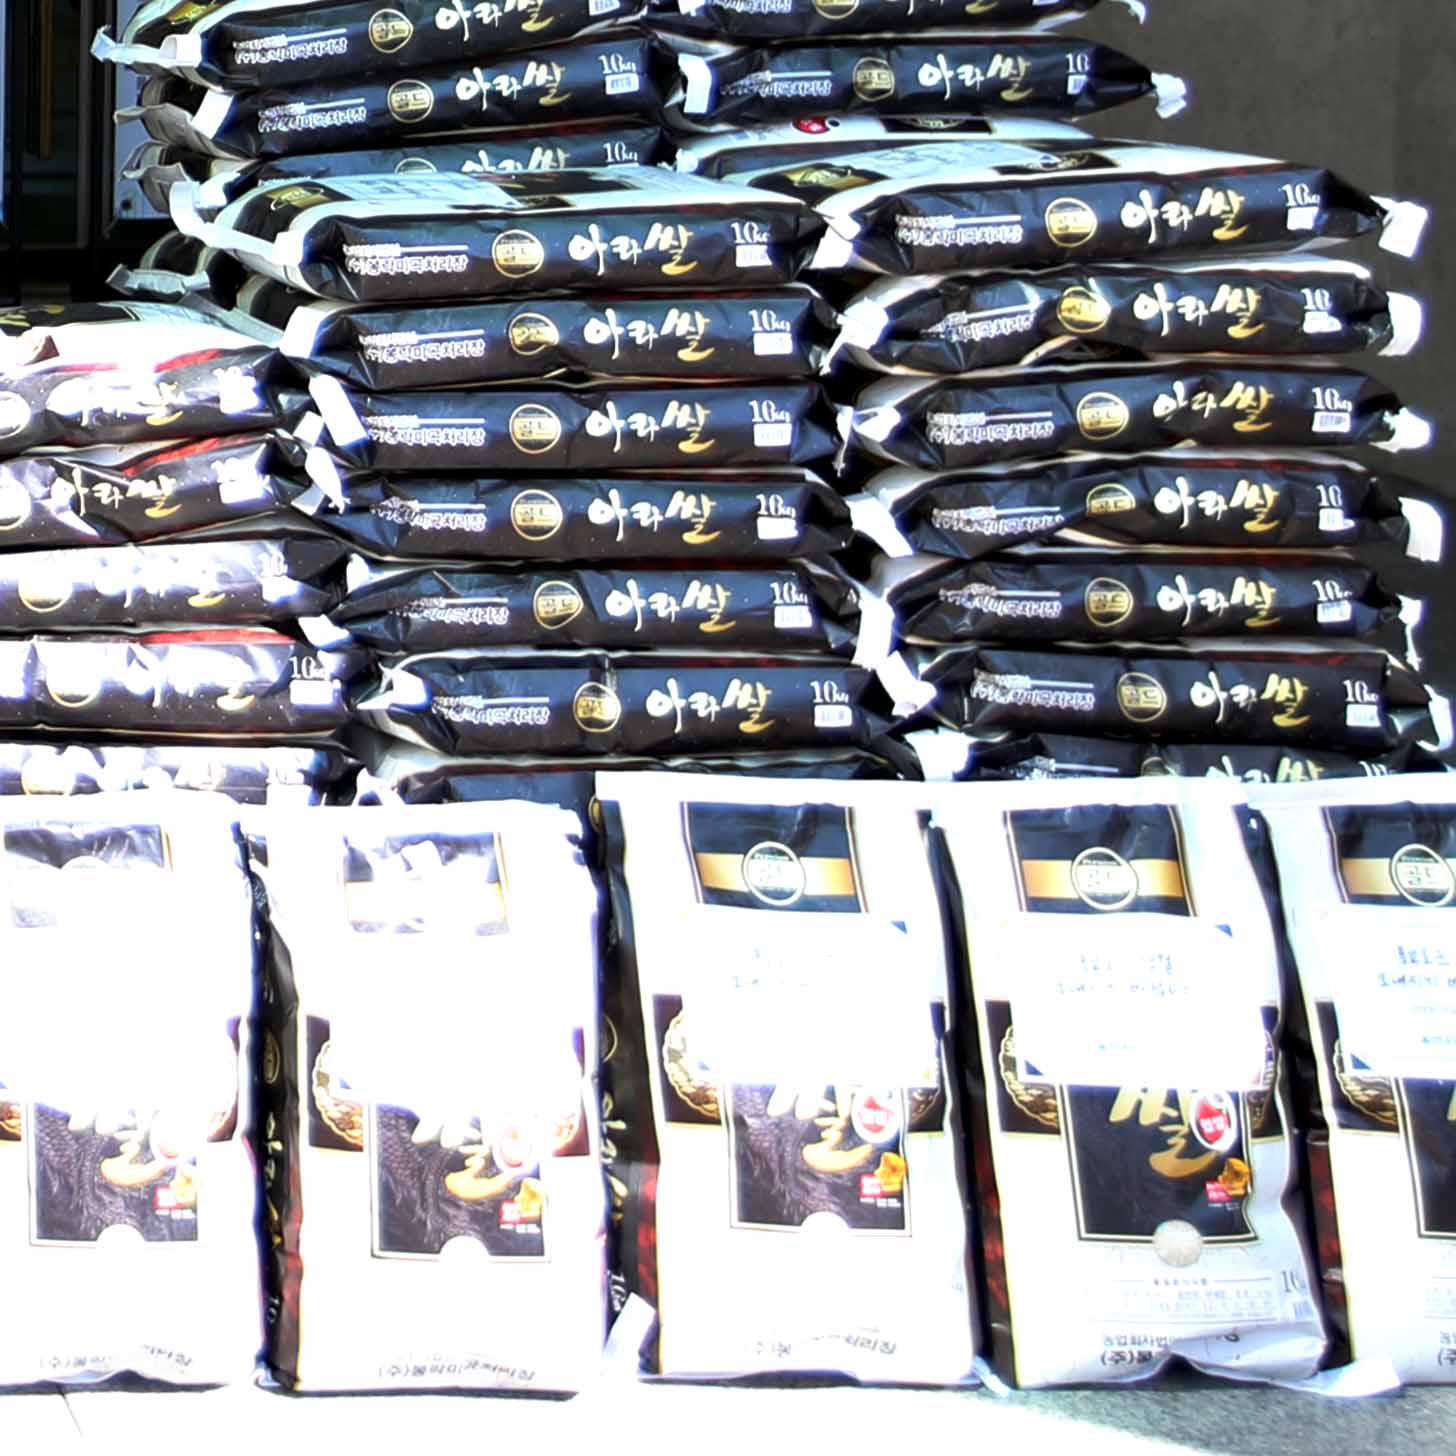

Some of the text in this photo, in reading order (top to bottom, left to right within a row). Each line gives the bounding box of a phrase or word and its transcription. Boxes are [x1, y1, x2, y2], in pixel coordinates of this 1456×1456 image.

[456, 63, 570, 105] 아라쌀
[919, 53, 1032, 100] 아라쌀
[1121, 188, 1248, 242] 아라쌀
[569, 222, 697, 274] 아라쌀
[584, 308, 713, 362] 아라쌀
[1132, 283, 1265, 339] 아라쌀
[586, 400, 714, 454] 아라쌀
[1153, 380, 1273, 433] 아라쌀
[588, 490, 719, 543] 아라쌀
[1154, 477, 1279, 533] 아라쌀
[605, 579, 735, 632] 아라쌀
[1157, 575, 1281, 628] 아라쌀
[646, 678, 773, 733] 아라쌀
[1191, 672, 1311, 728] 아라쌀
